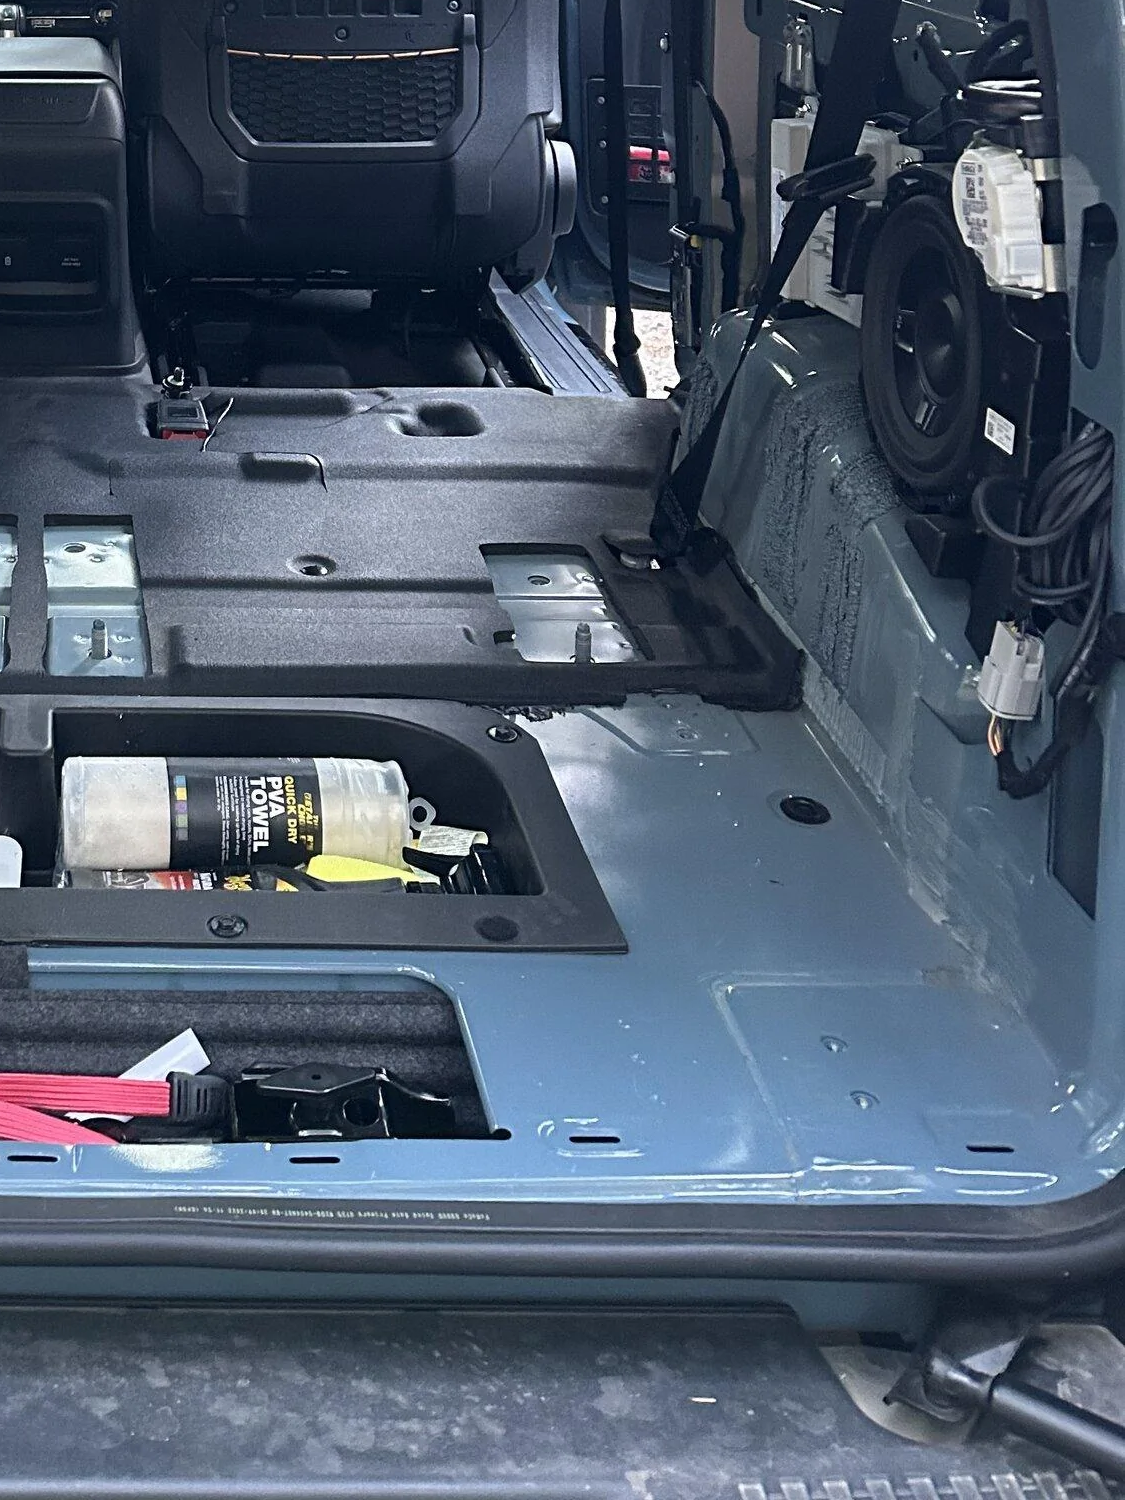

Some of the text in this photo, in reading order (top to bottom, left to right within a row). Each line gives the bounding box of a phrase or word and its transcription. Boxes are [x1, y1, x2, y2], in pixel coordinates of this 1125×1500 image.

[249, 776, 270, 852] TOWEL
[267, 776, 285, 818] PVA
[284, 776, 297, 815] QUICK
[287, 818, 297, 844] DRY
